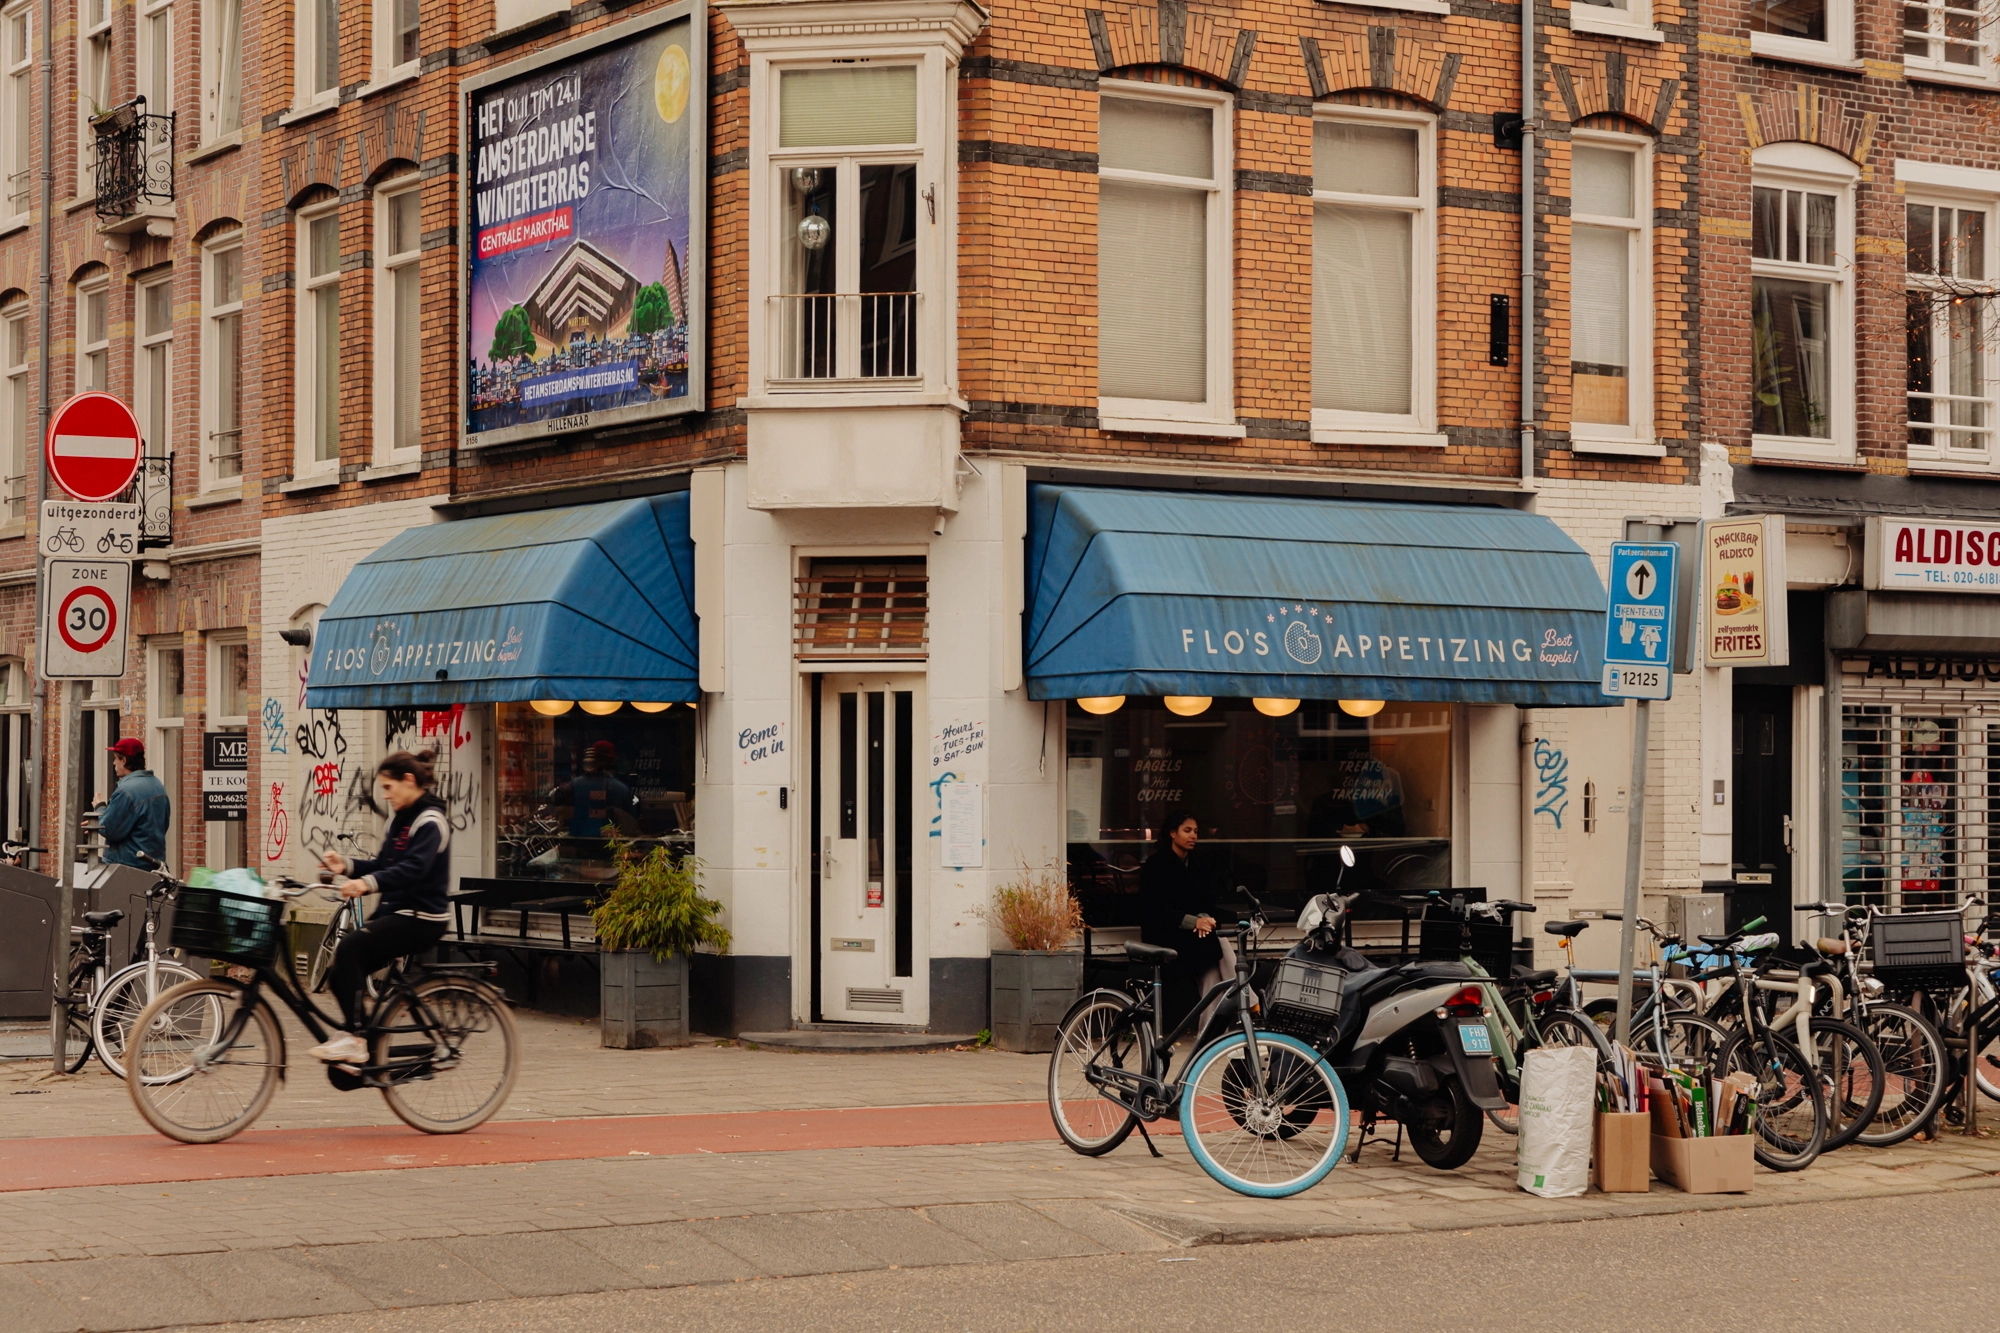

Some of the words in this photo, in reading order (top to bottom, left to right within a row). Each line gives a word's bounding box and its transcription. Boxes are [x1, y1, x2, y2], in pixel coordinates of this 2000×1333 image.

[478, 98, 504, 139] HET
[507, 95, 528, 123] 01.11
[531, 90, 553, 120] T/M
[556, 77, 581, 107] 24.11
[477, 111, 596, 185] AMSTERDAMSE
[477, 161, 590, 227] WINTERTERRAS
[481, 228, 522, 253] CENTRALE
[523, 215, 569, 242] MARKTHAL
[547, 415, 590, 433] HILLENAAR
[47, 507, 137, 522] uitgezonderd
[1714, 532, 1758, 549] SNACKBAR
[1895, 527, 2000, 567] ALDISC
[1719, 547, 1754, 560] ALDISCO
[72, 568, 108, 581] ZONE
[1925, 570, 1950, 583] TEL:
[1953, 571, 2000, 585] 020-6181
[69, 607, 107, 631] 30
[502, 626, 523, 647] Best
[1541, 628, 1573, 648] Best
[1717, 624, 1759, 635] zelfgemaakte
[1182, 628, 1269, 656] FLO'S
[1333, 633, 1532, 663] APPETIZING
[1714, 634, 1762, 653] FRITES
[325, 646, 366, 671] FLO'S
[392, 639, 497, 668] APPETIZING
[1540, 650, 1579, 667] bagels!
[1622, 672, 1659, 687] 12125
[738, 724, 778, 749] Come
[942, 722, 974, 740] Hours
[219, 741, 247, 757] ME
[943, 729, 984, 752] TUES-FRI
[750, 746, 768, 761] on
[771, 739, 785, 754] in
[943, 741, 984, 762] SAT-SUN
[635, 758, 662, 771] TREATS
[1134, 759, 1183, 772] BAGELS
[1338, 760, 1384, 772] TREATS
[209, 776, 223, 786] TE
[1150, 775, 1171, 787] Hot
[1137, 789, 1183, 801] COFFEE
[1332, 788, 1393, 800] TAKEAWAY
[1469, 1027, 1487, 1037] FHX
[1471, 1038, 1488, 1049] 91T
